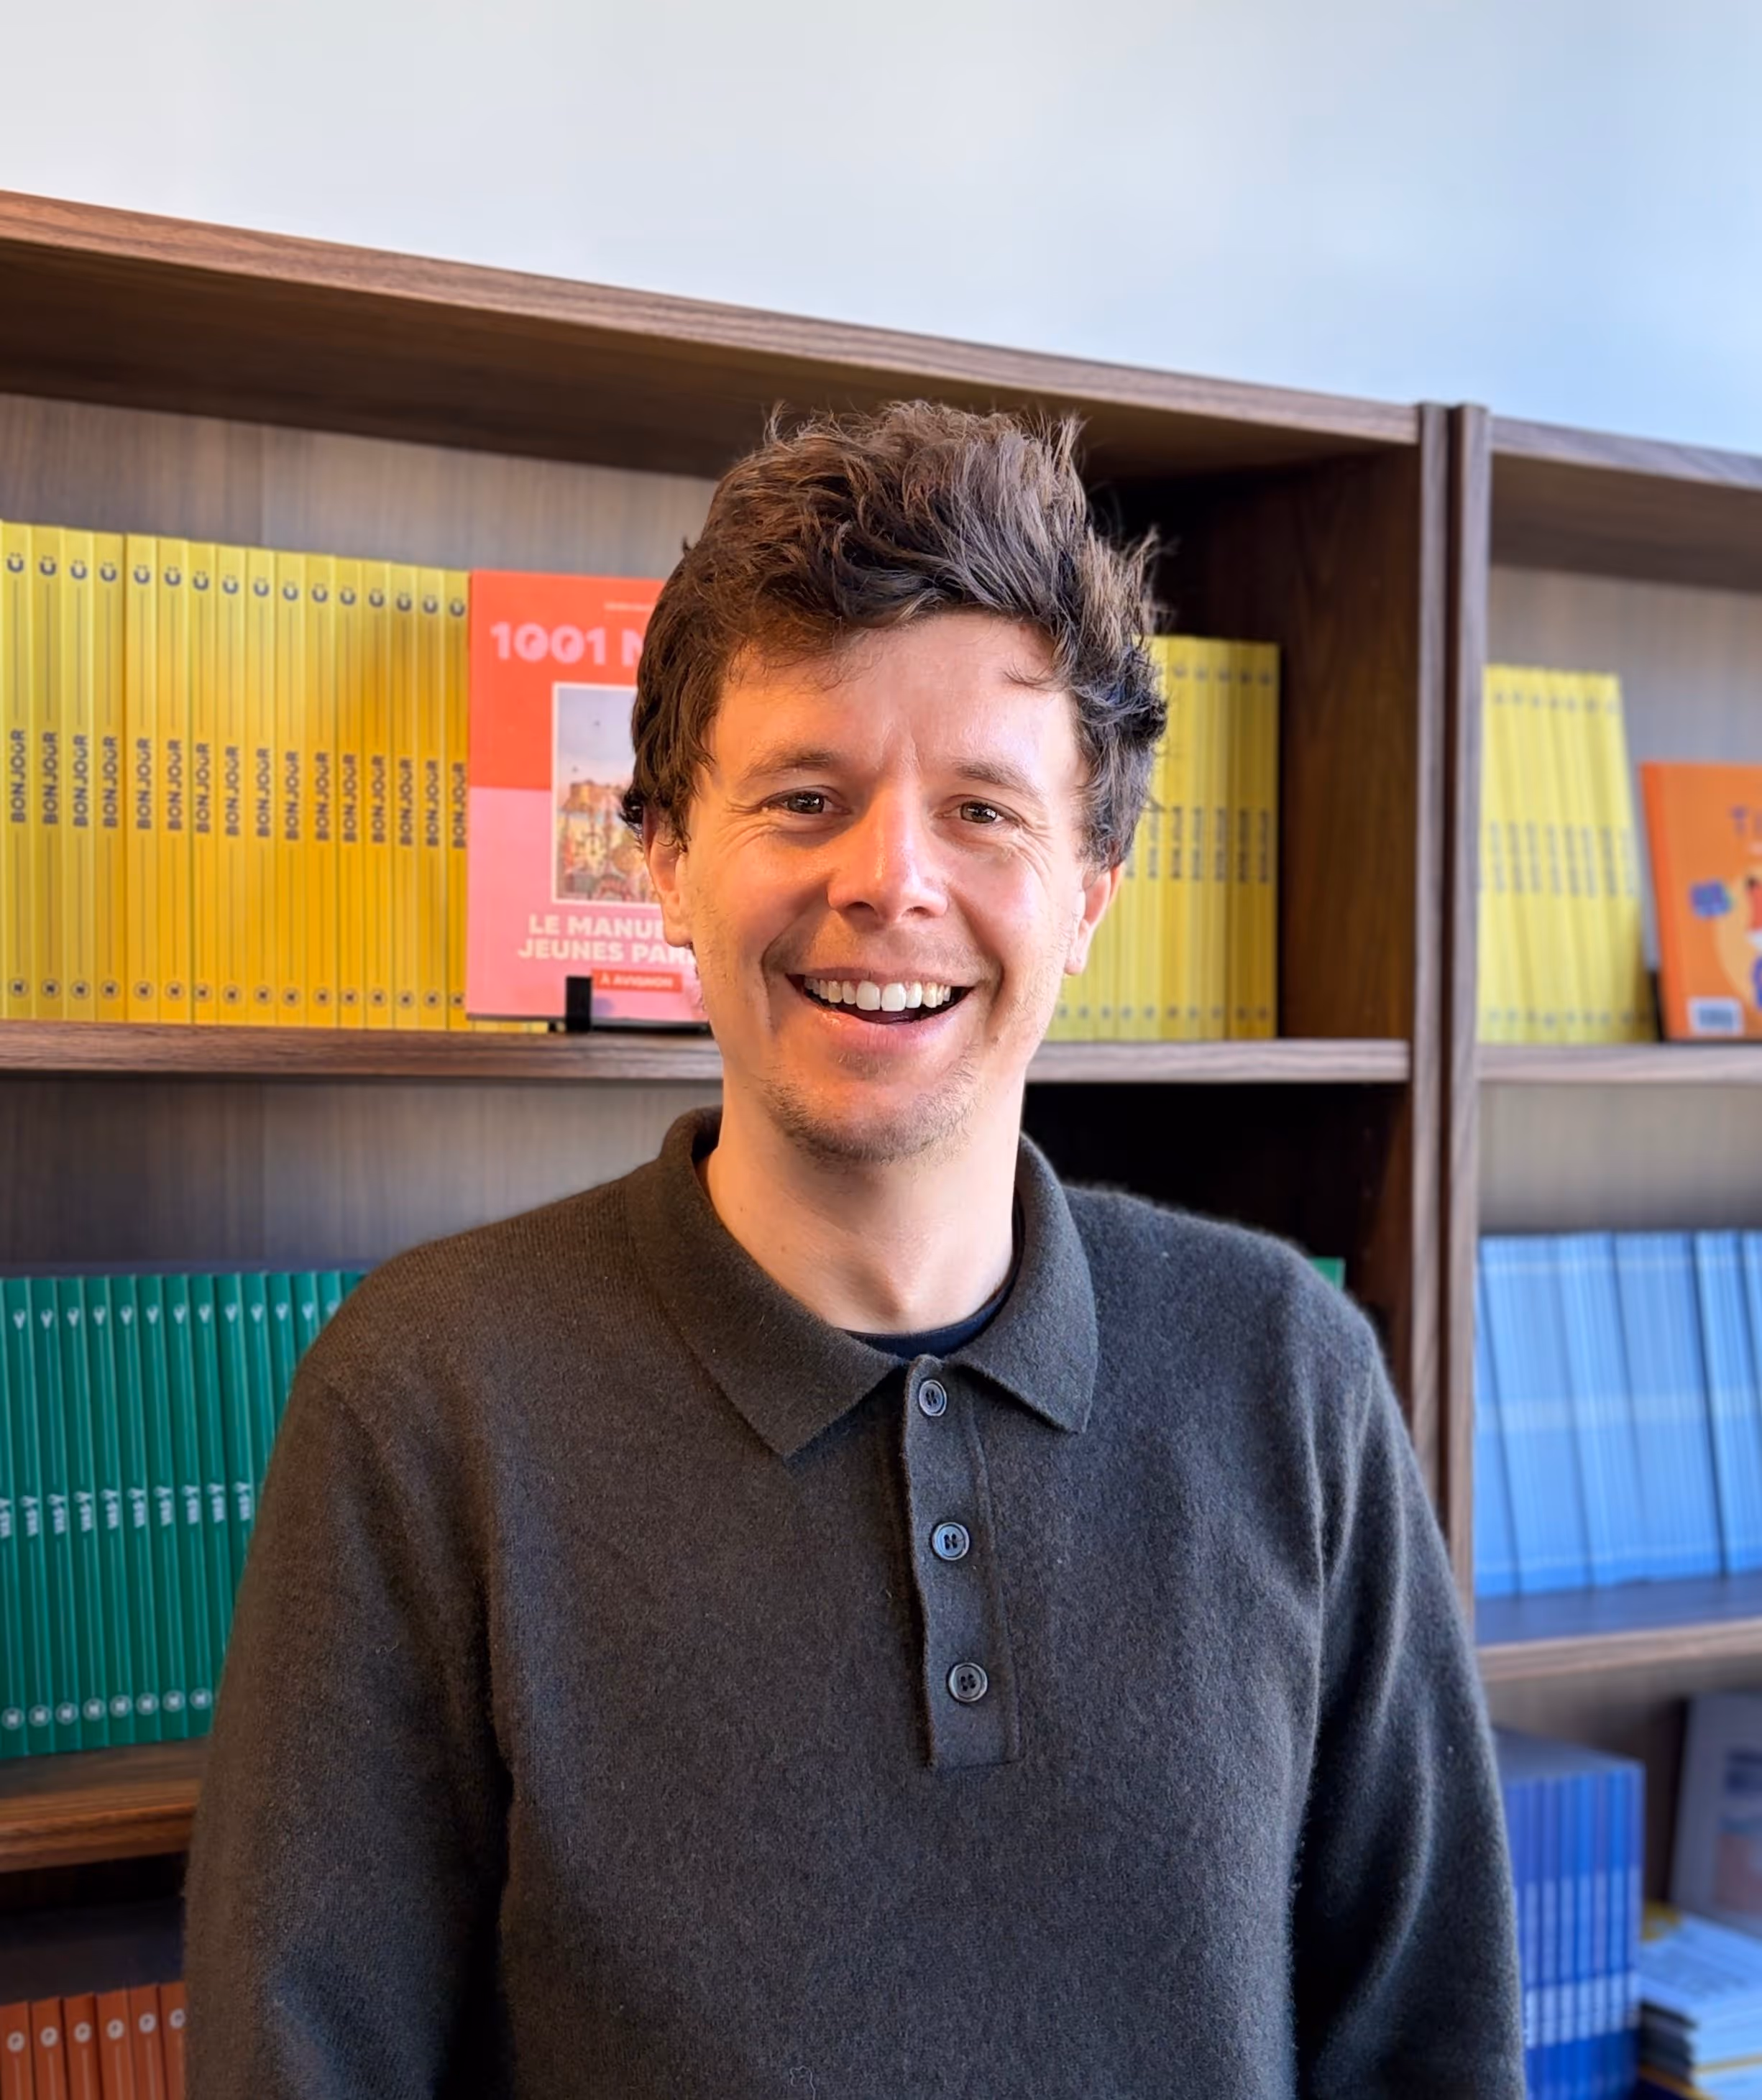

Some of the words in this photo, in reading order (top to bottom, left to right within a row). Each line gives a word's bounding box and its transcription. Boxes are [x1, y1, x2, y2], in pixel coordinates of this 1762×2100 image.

[490, 621, 605, 666] 1001
[528, 914, 560, 935] LE
[518, 938, 624, 962] JEUNES
